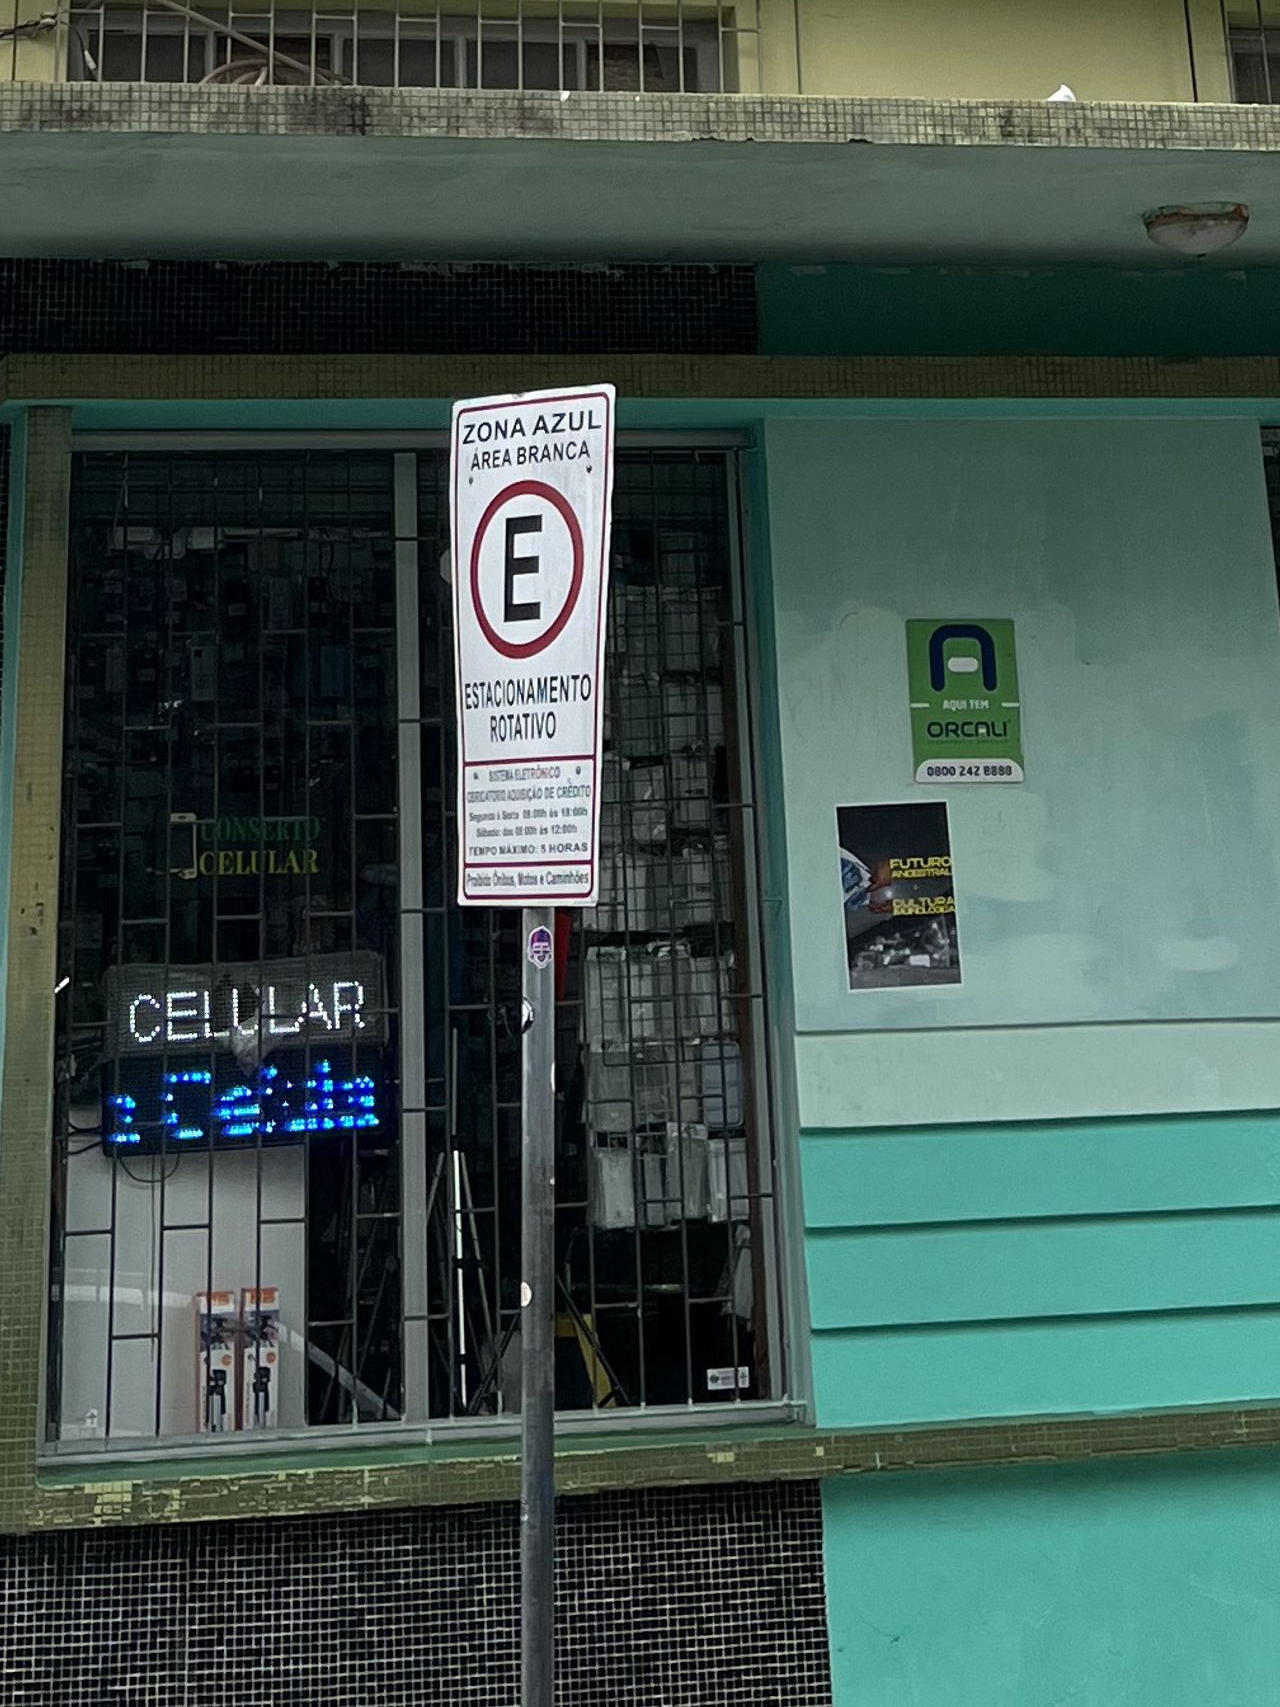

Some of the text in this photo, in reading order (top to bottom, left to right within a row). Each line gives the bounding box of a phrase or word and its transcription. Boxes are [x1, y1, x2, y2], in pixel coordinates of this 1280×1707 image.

[462, 410, 602, 444] ZONA AZUL
[470, 440, 591, 471] ÁREA BRANCA
[504, 514, 543, 622] E
[464, 673, 592, 710] ESTACIONAMENTO
[943, 699, 989, 711] AQUI TEM
[489, 711, 557, 743] ROTATIVO
[927, 721, 1007, 738] ORCALI
[199, 849, 318, 876] CELULAR
[469, 846, 498, 856] TEMPO
[541, 844, 547, 853] 5
[548, 842, 588, 852] HORAS
[889, 856, 952, 870] FUTURO
